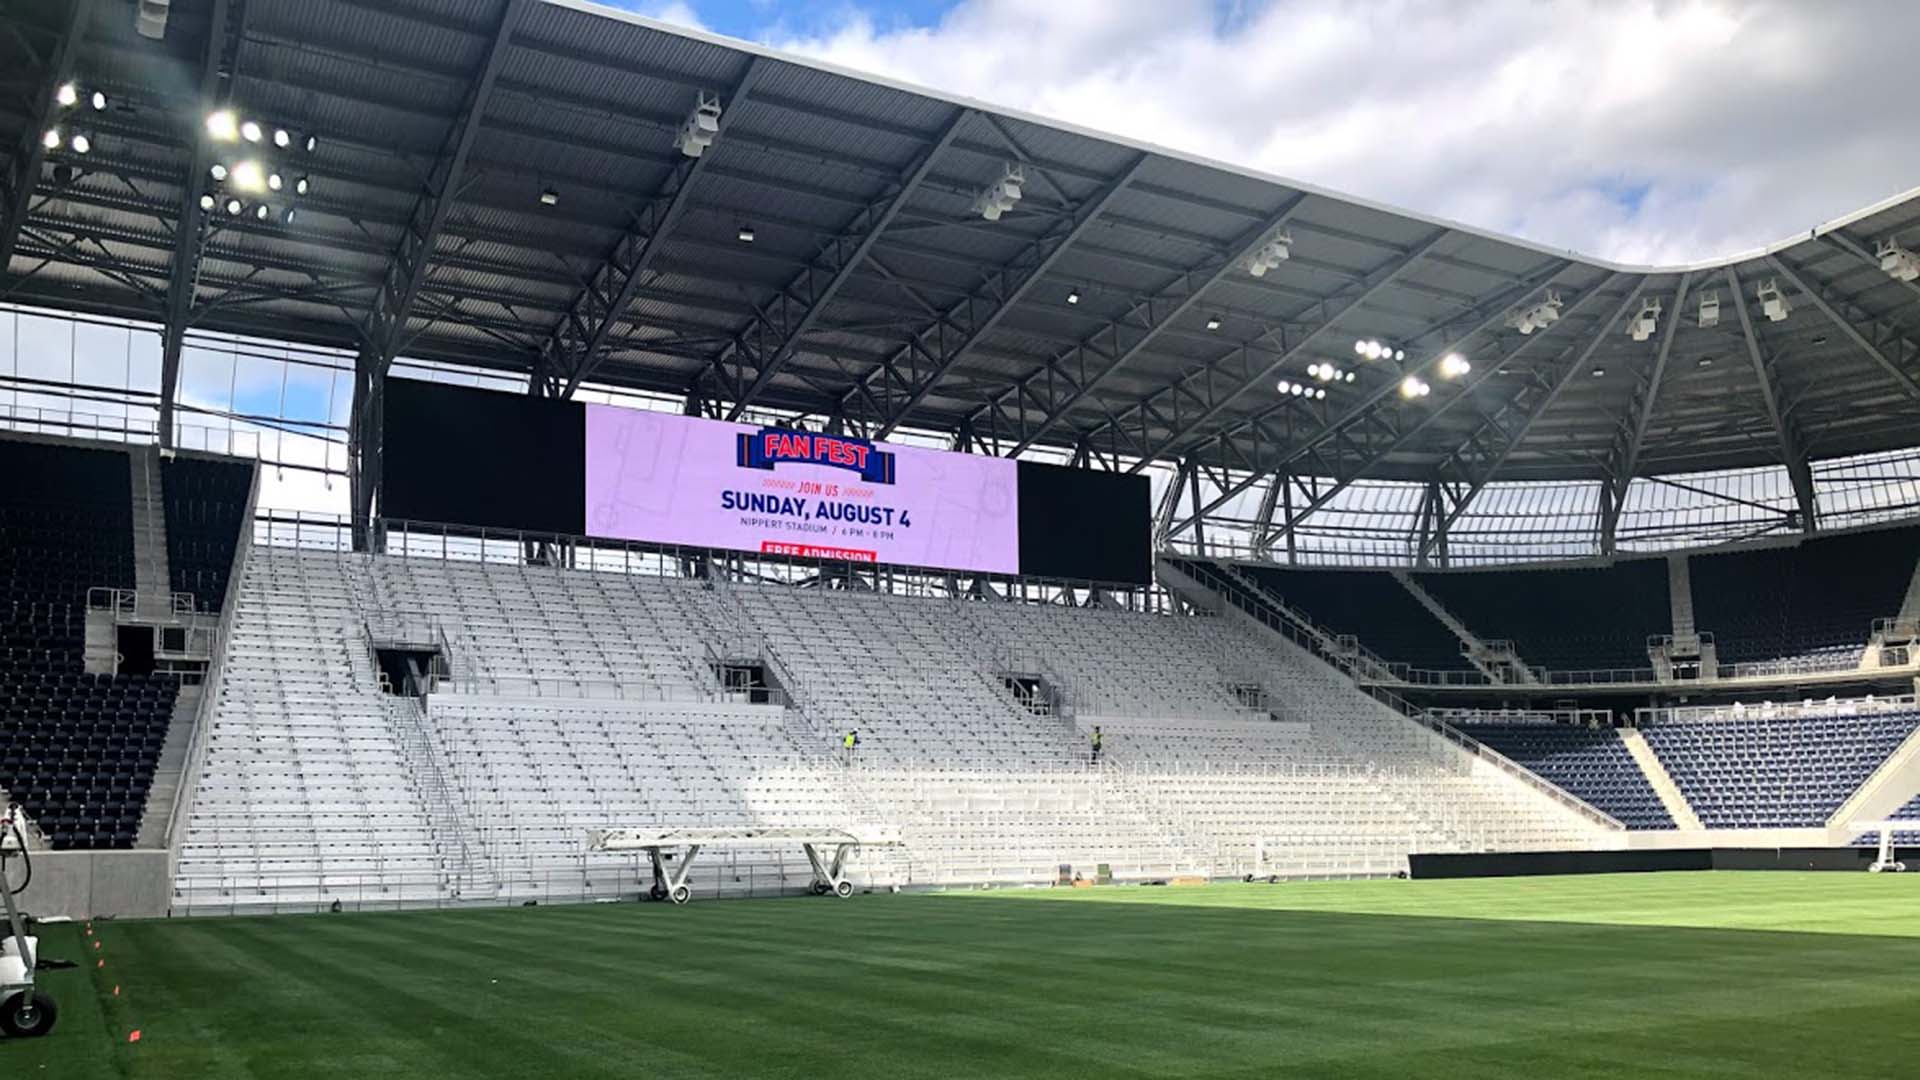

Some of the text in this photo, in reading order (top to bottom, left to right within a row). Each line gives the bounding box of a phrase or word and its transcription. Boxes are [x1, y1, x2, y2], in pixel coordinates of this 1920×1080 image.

[765, 434, 869, 468] FAN FEST
[798, 481, 838, 497] JOIN US
[721, 490, 911, 528] SUNDAY, AUGUST 4
[740, 518, 782, 528] NIPPERT
[785, 521, 827, 533] STADIUM
[849, 528, 864, 537] PM
[880, 531, 894, 540] PM
[766, 544, 872, 562] FREE ADMISSION
